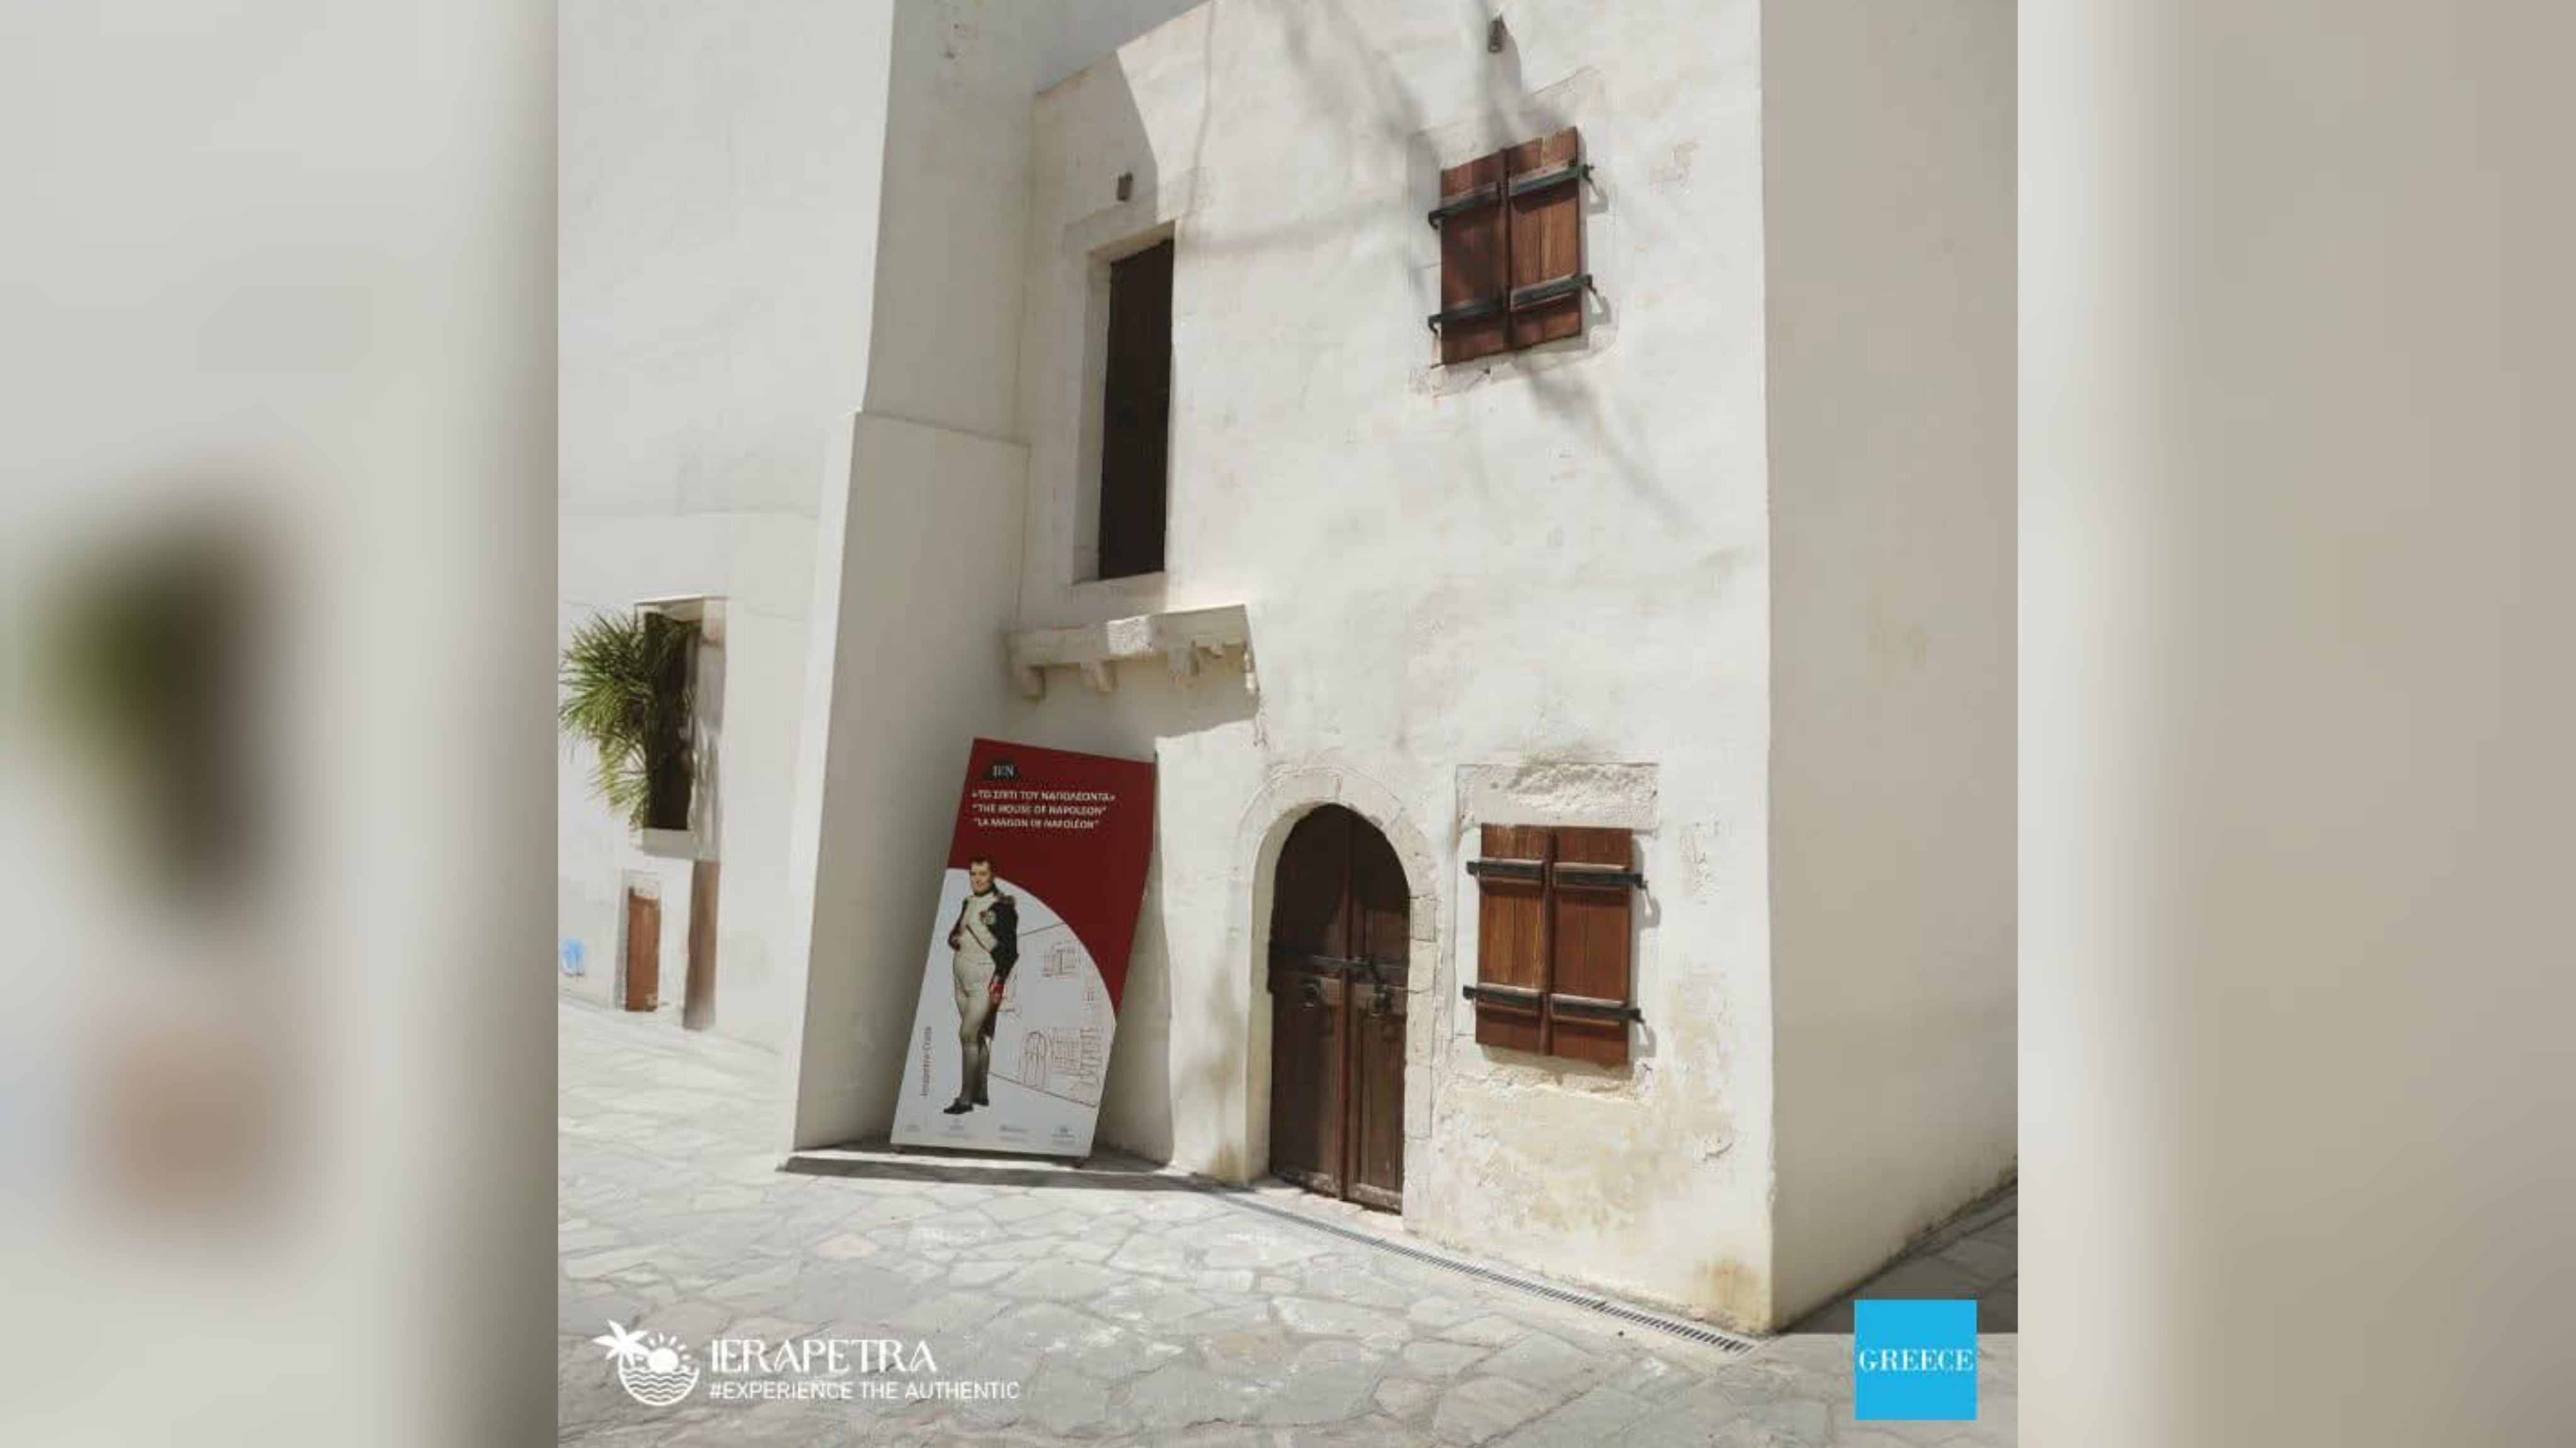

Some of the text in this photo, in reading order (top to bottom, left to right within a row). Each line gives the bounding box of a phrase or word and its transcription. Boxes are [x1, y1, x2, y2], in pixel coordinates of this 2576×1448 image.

[997, 805, 1032, 814] HOUSE
[1034, 805, 1046, 814] OF
[991, 818, 1028, 828] MAISON
